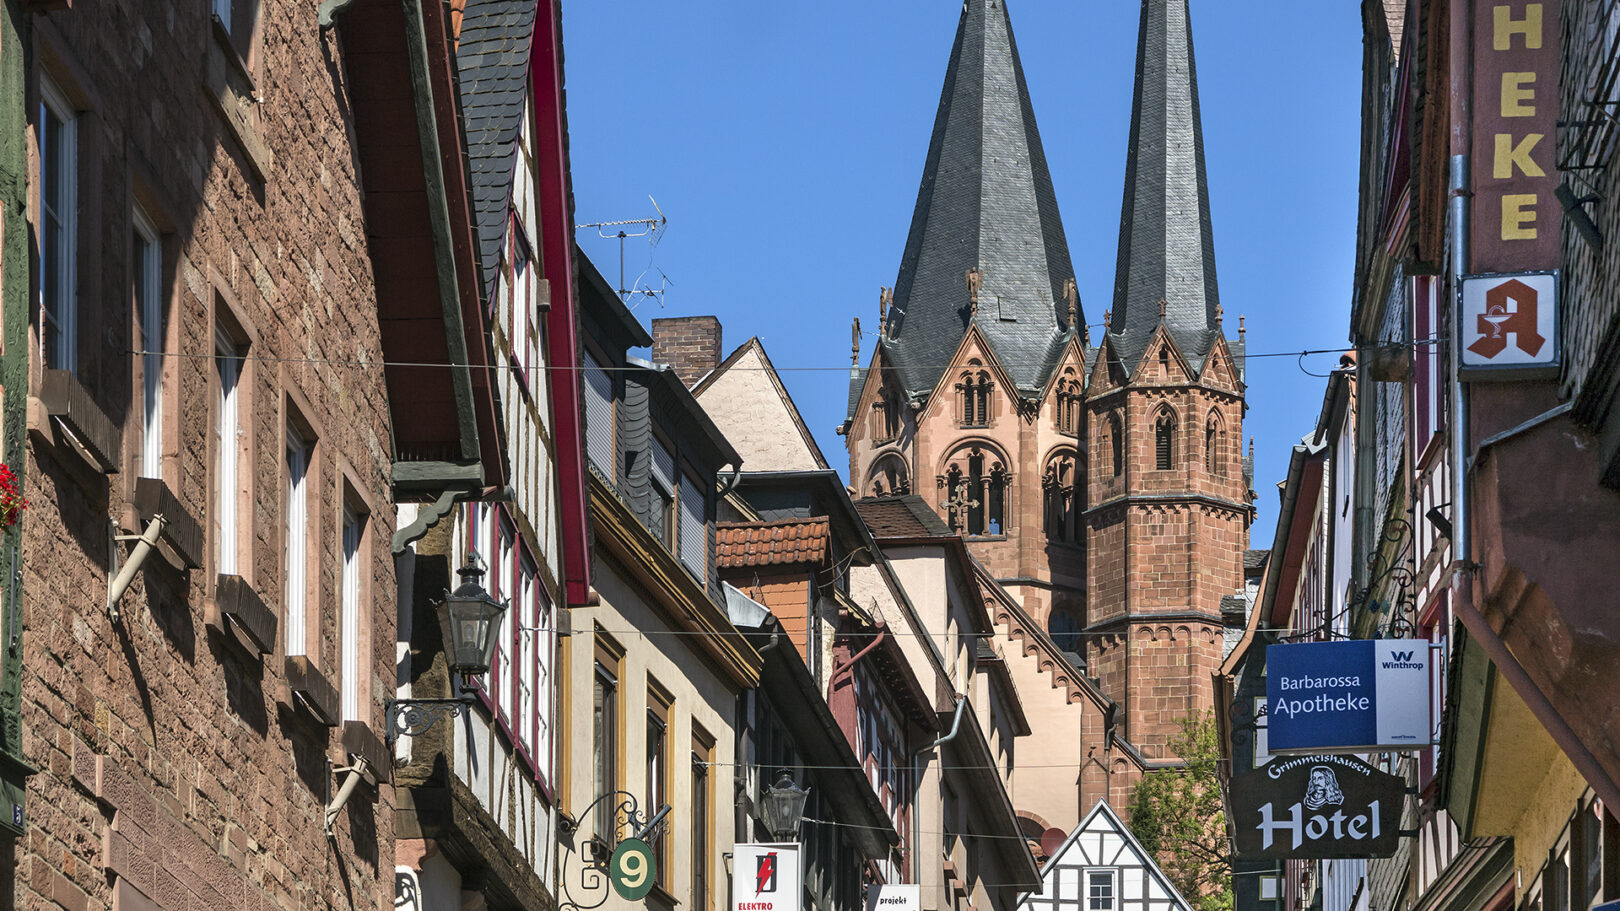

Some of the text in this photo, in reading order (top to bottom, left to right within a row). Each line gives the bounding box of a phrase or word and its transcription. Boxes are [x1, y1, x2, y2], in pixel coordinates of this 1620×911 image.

[1493, 4, 1546, 240] HEKE
[1382, 661, 1424, 671] Winthrop
[1280, 675, 1361, 690] Barbarossa
[1274, 692, 1370, 719] Apotheke
[1255, 799, 1381, 851] Hotel
[619, 849, 648, 888] 9
[738, 902, 773, 911] ELEKTRO
[880, 895, 907, 905] projekt
